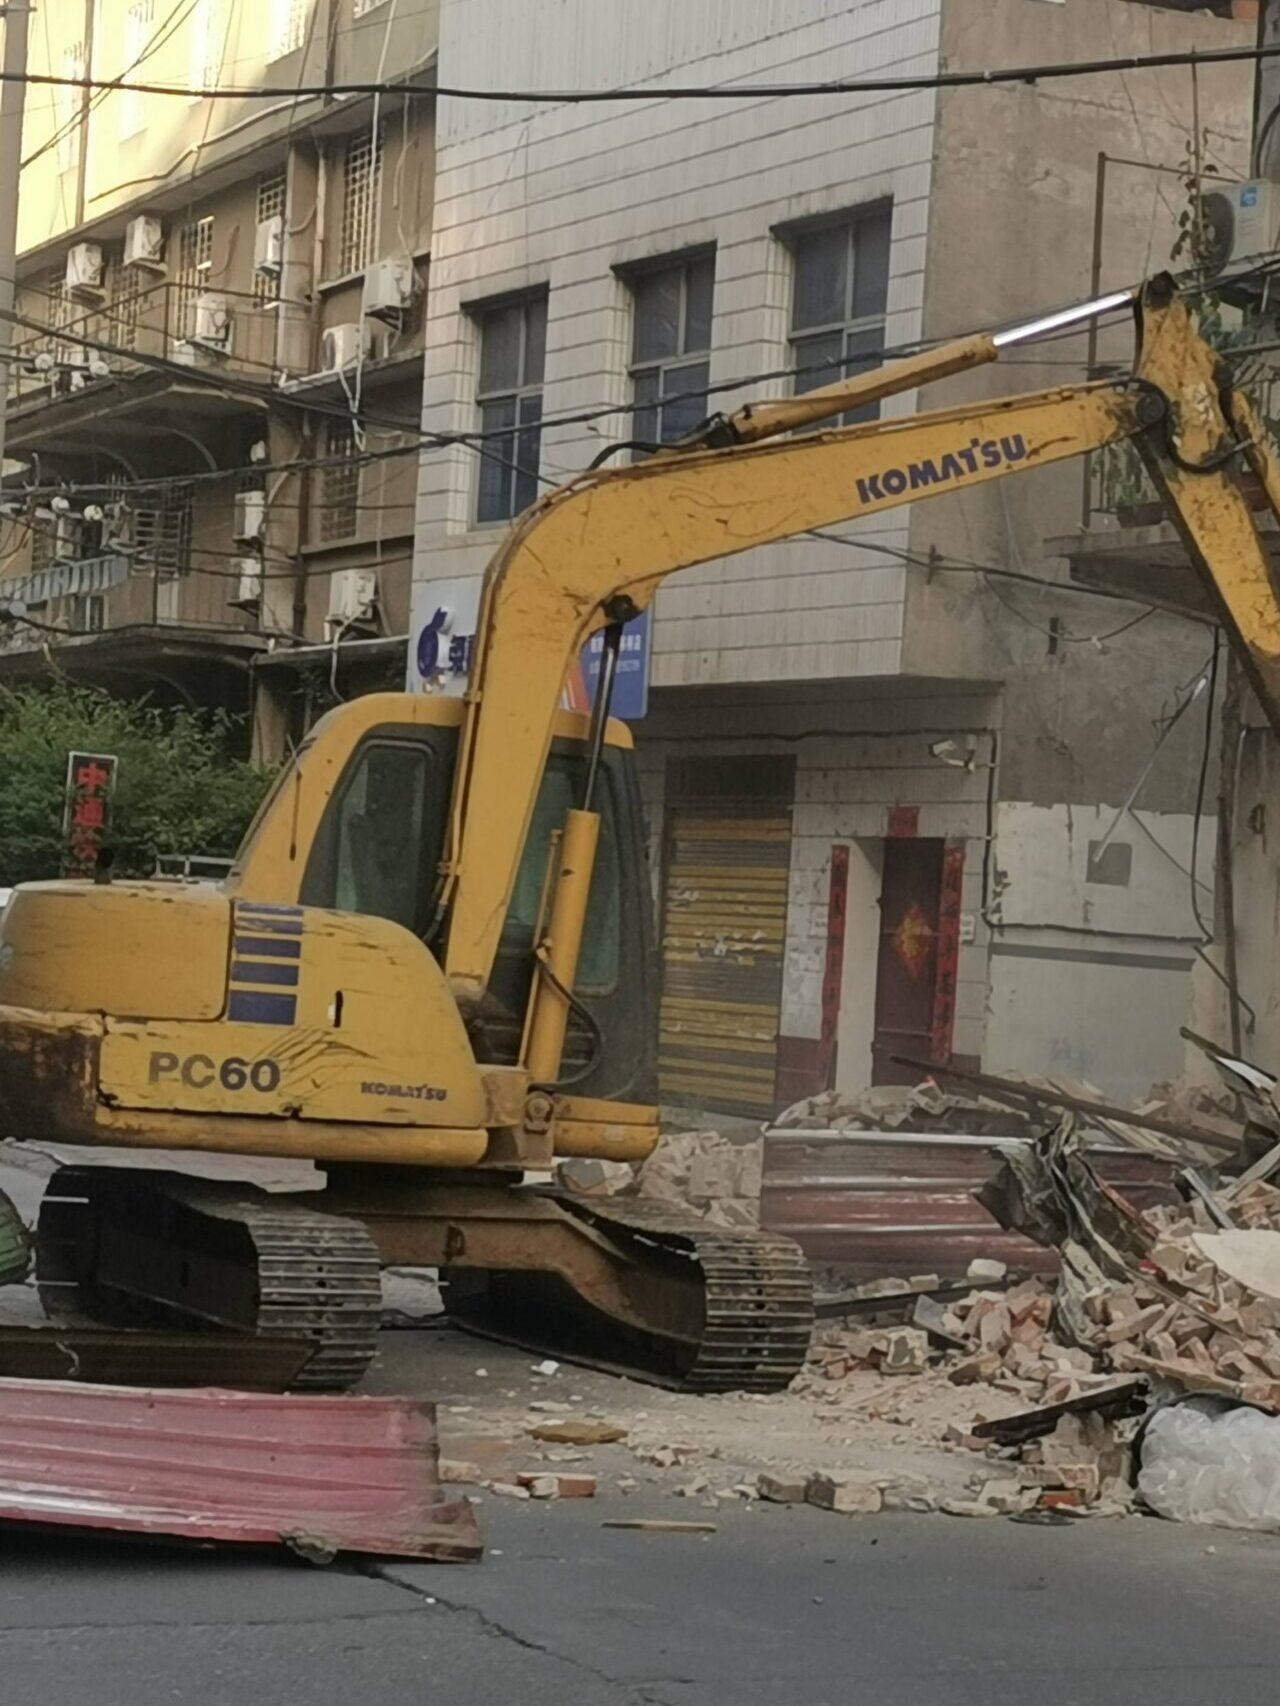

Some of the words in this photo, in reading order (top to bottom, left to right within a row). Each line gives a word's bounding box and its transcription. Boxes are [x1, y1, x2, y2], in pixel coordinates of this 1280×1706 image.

[856, 434, 1026, 504] KOMATSU
[149, 1051, 280, 1093] PC60
[361, 1081, 447, 1101] KOMATSU
